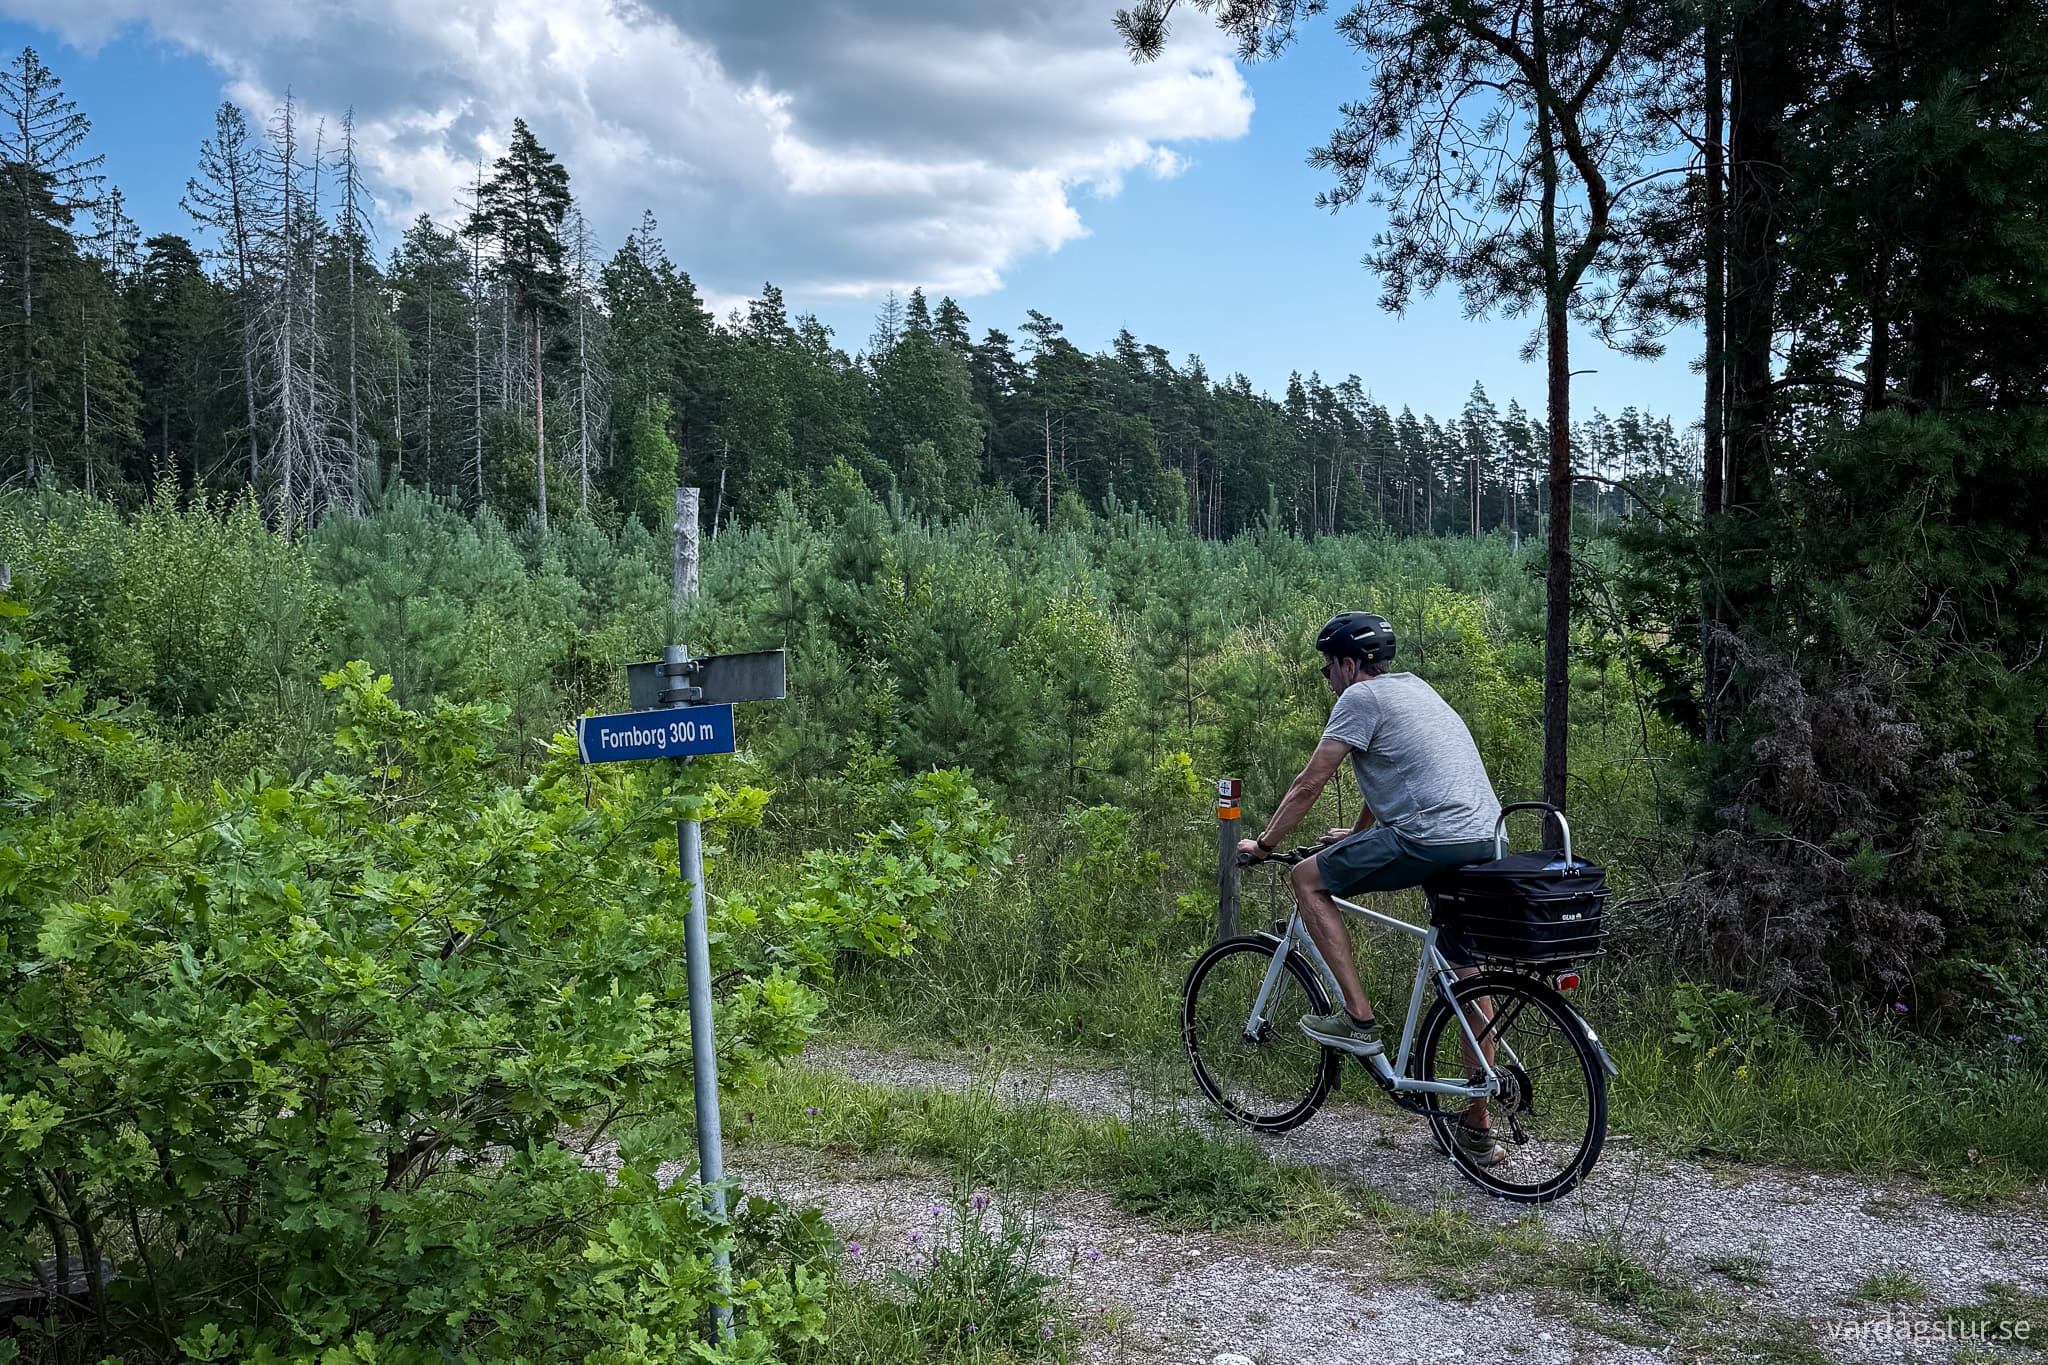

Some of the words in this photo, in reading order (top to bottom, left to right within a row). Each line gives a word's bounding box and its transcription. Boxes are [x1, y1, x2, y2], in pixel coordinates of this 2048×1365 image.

[601, 726, 665, 749] Fornborg
[669, 721, 695, 742] 300
[700, 723, 714, 741] m
